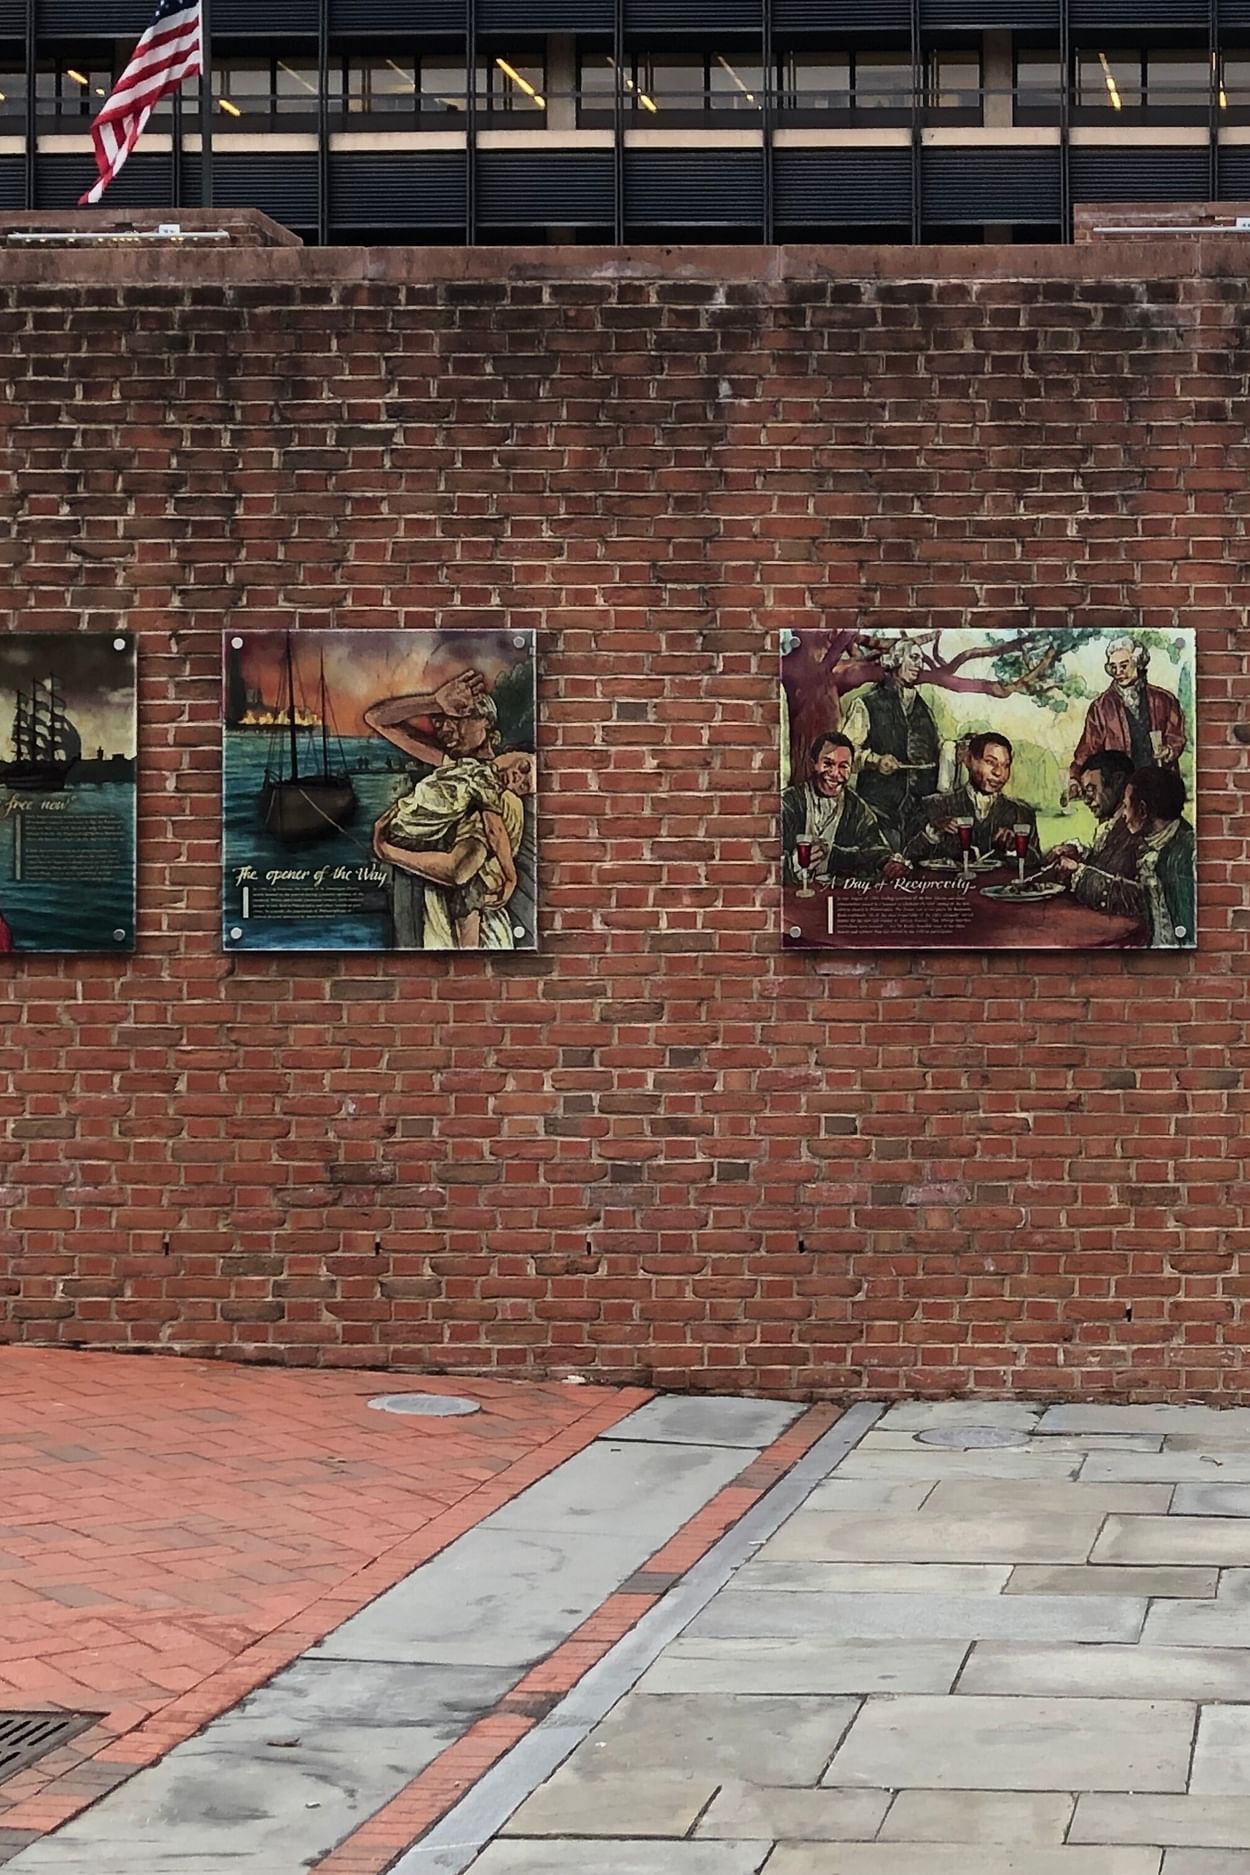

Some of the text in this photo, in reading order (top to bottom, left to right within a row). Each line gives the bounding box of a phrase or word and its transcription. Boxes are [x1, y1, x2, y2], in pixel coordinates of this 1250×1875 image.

[232, 863, 388, 888] The opener of the Way
[843, 876, 871, 894] Day
[890, 876, 977, 895] Reciprocity
